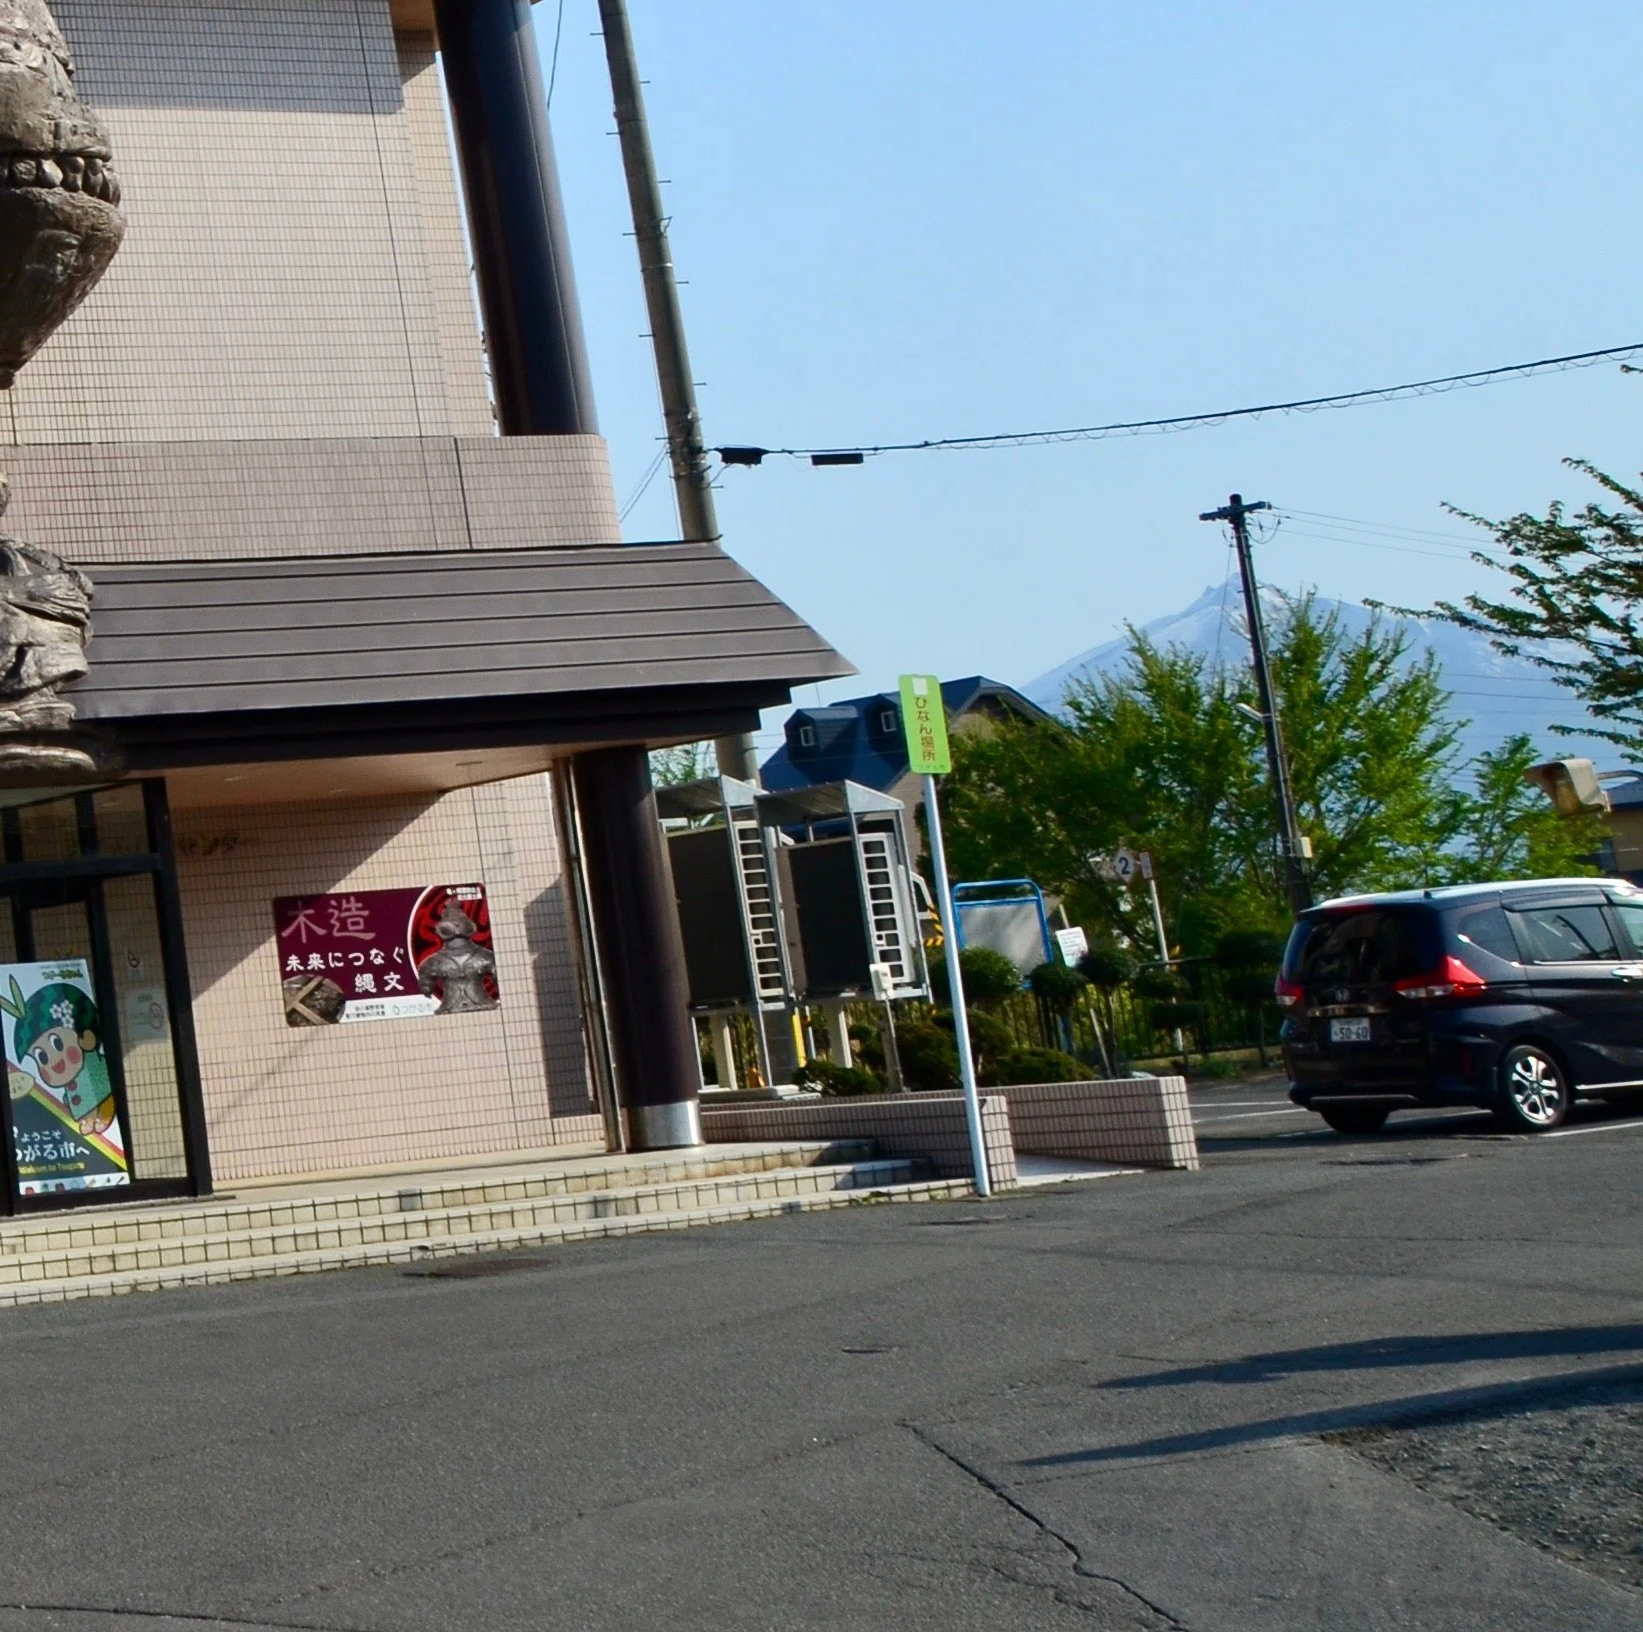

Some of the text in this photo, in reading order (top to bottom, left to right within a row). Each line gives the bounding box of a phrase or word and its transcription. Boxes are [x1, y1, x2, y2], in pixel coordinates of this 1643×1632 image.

[915, 696, 936, 762] ひなん場所
[1118, 856, 1131, 875] 2
[281, 896, 376, 944] 木造
[285, 945, 405, 972] 未来につなぐ
[354, 971, 405, 993] 縄文
